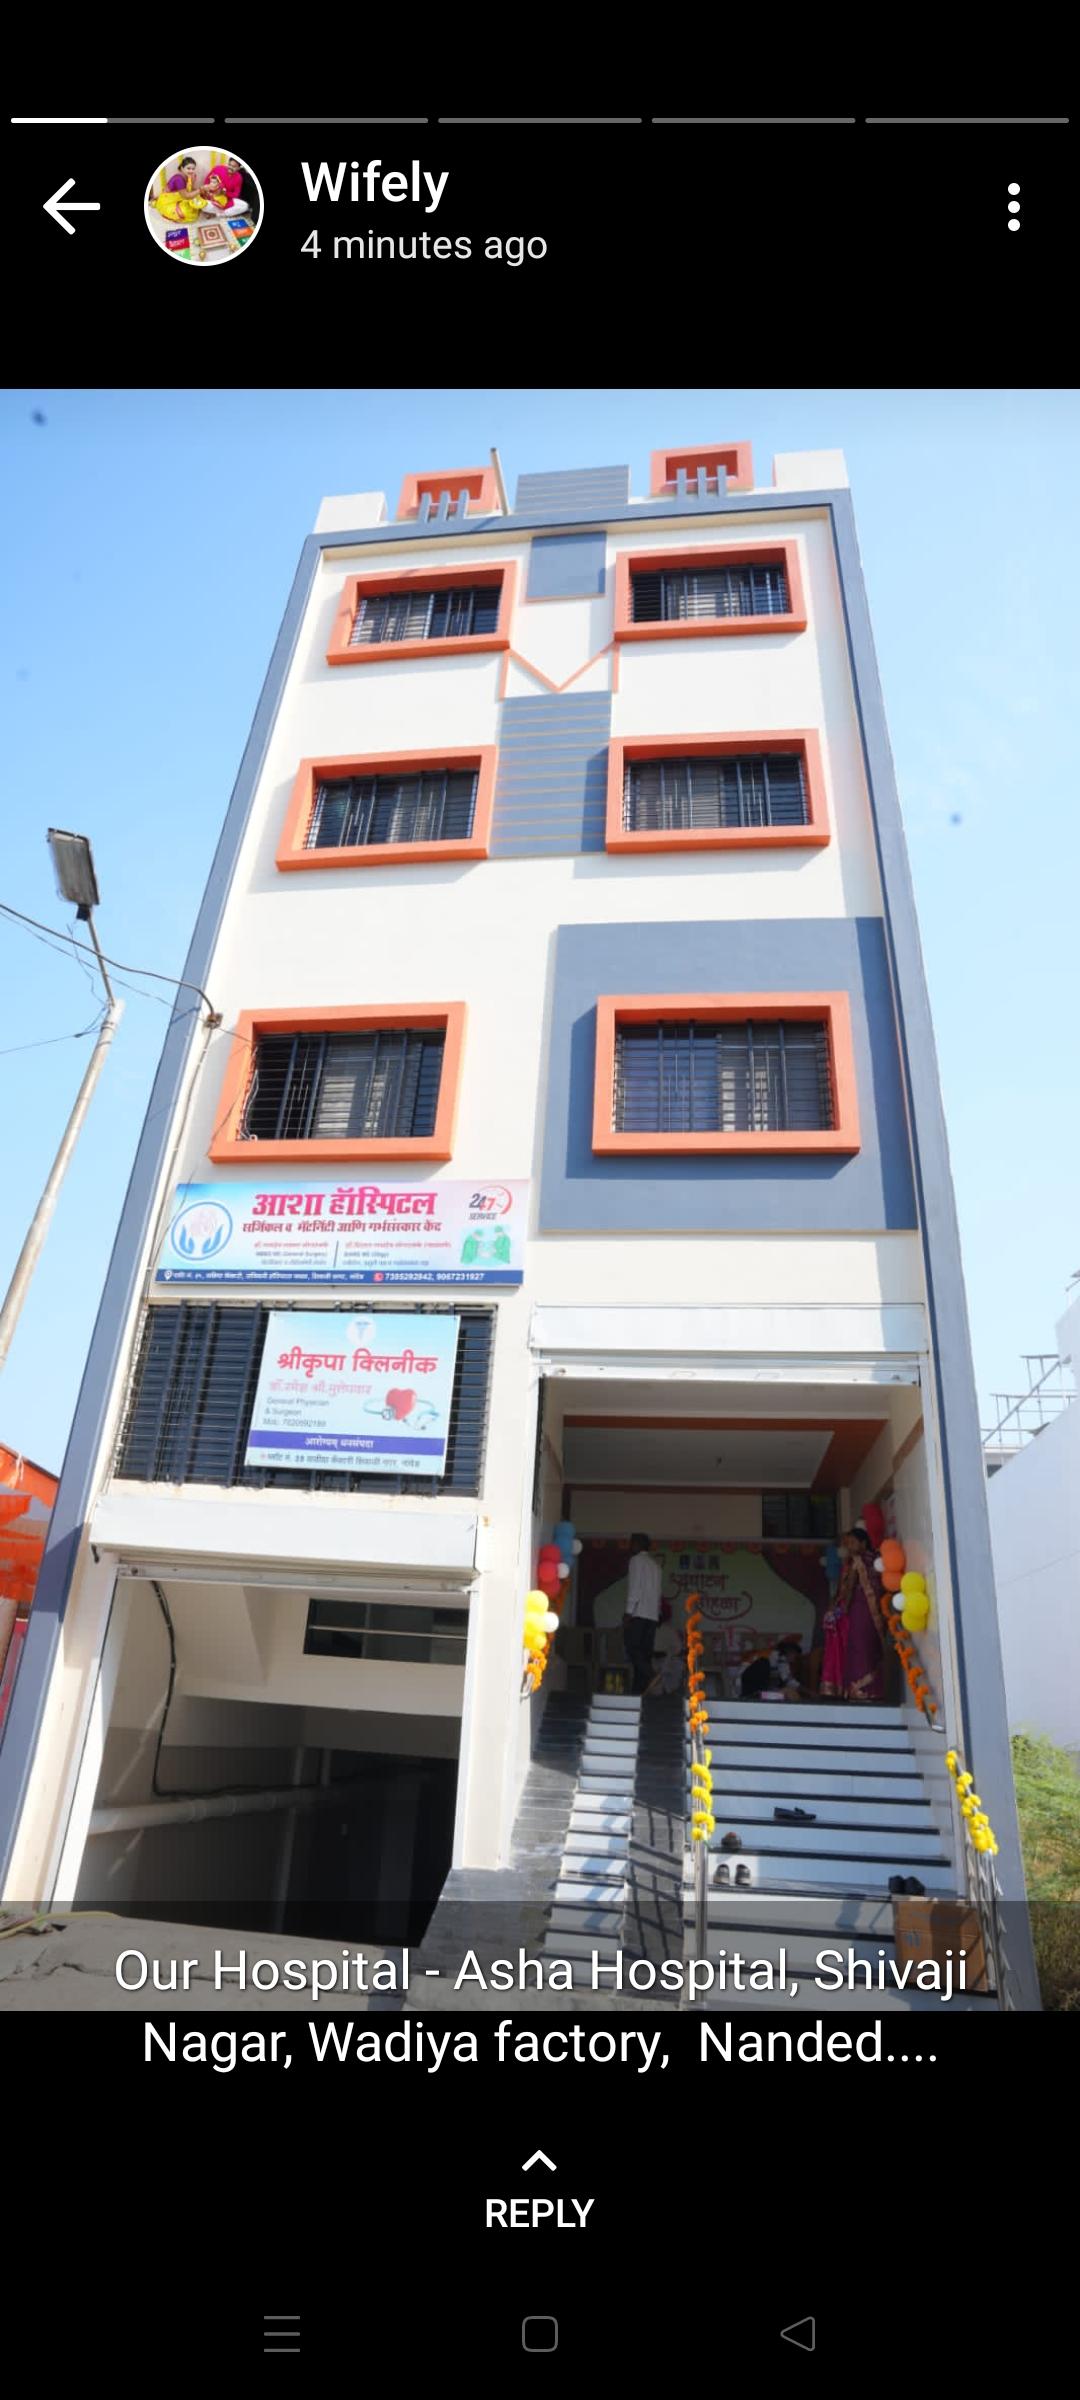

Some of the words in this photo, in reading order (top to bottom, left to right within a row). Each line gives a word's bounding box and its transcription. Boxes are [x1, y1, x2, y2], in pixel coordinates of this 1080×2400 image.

[252, 1193, 325, 1216] आशा
[329, 1187, 438, 1216] हॉस्पिटल
[285, 1223, 292, 1232] व
[337, 1220, 365, 1232] आणि
[277, 1346, 347, 1377] श्रीकृपा
[352, 1348, 438, 1375] क्लिनीक
